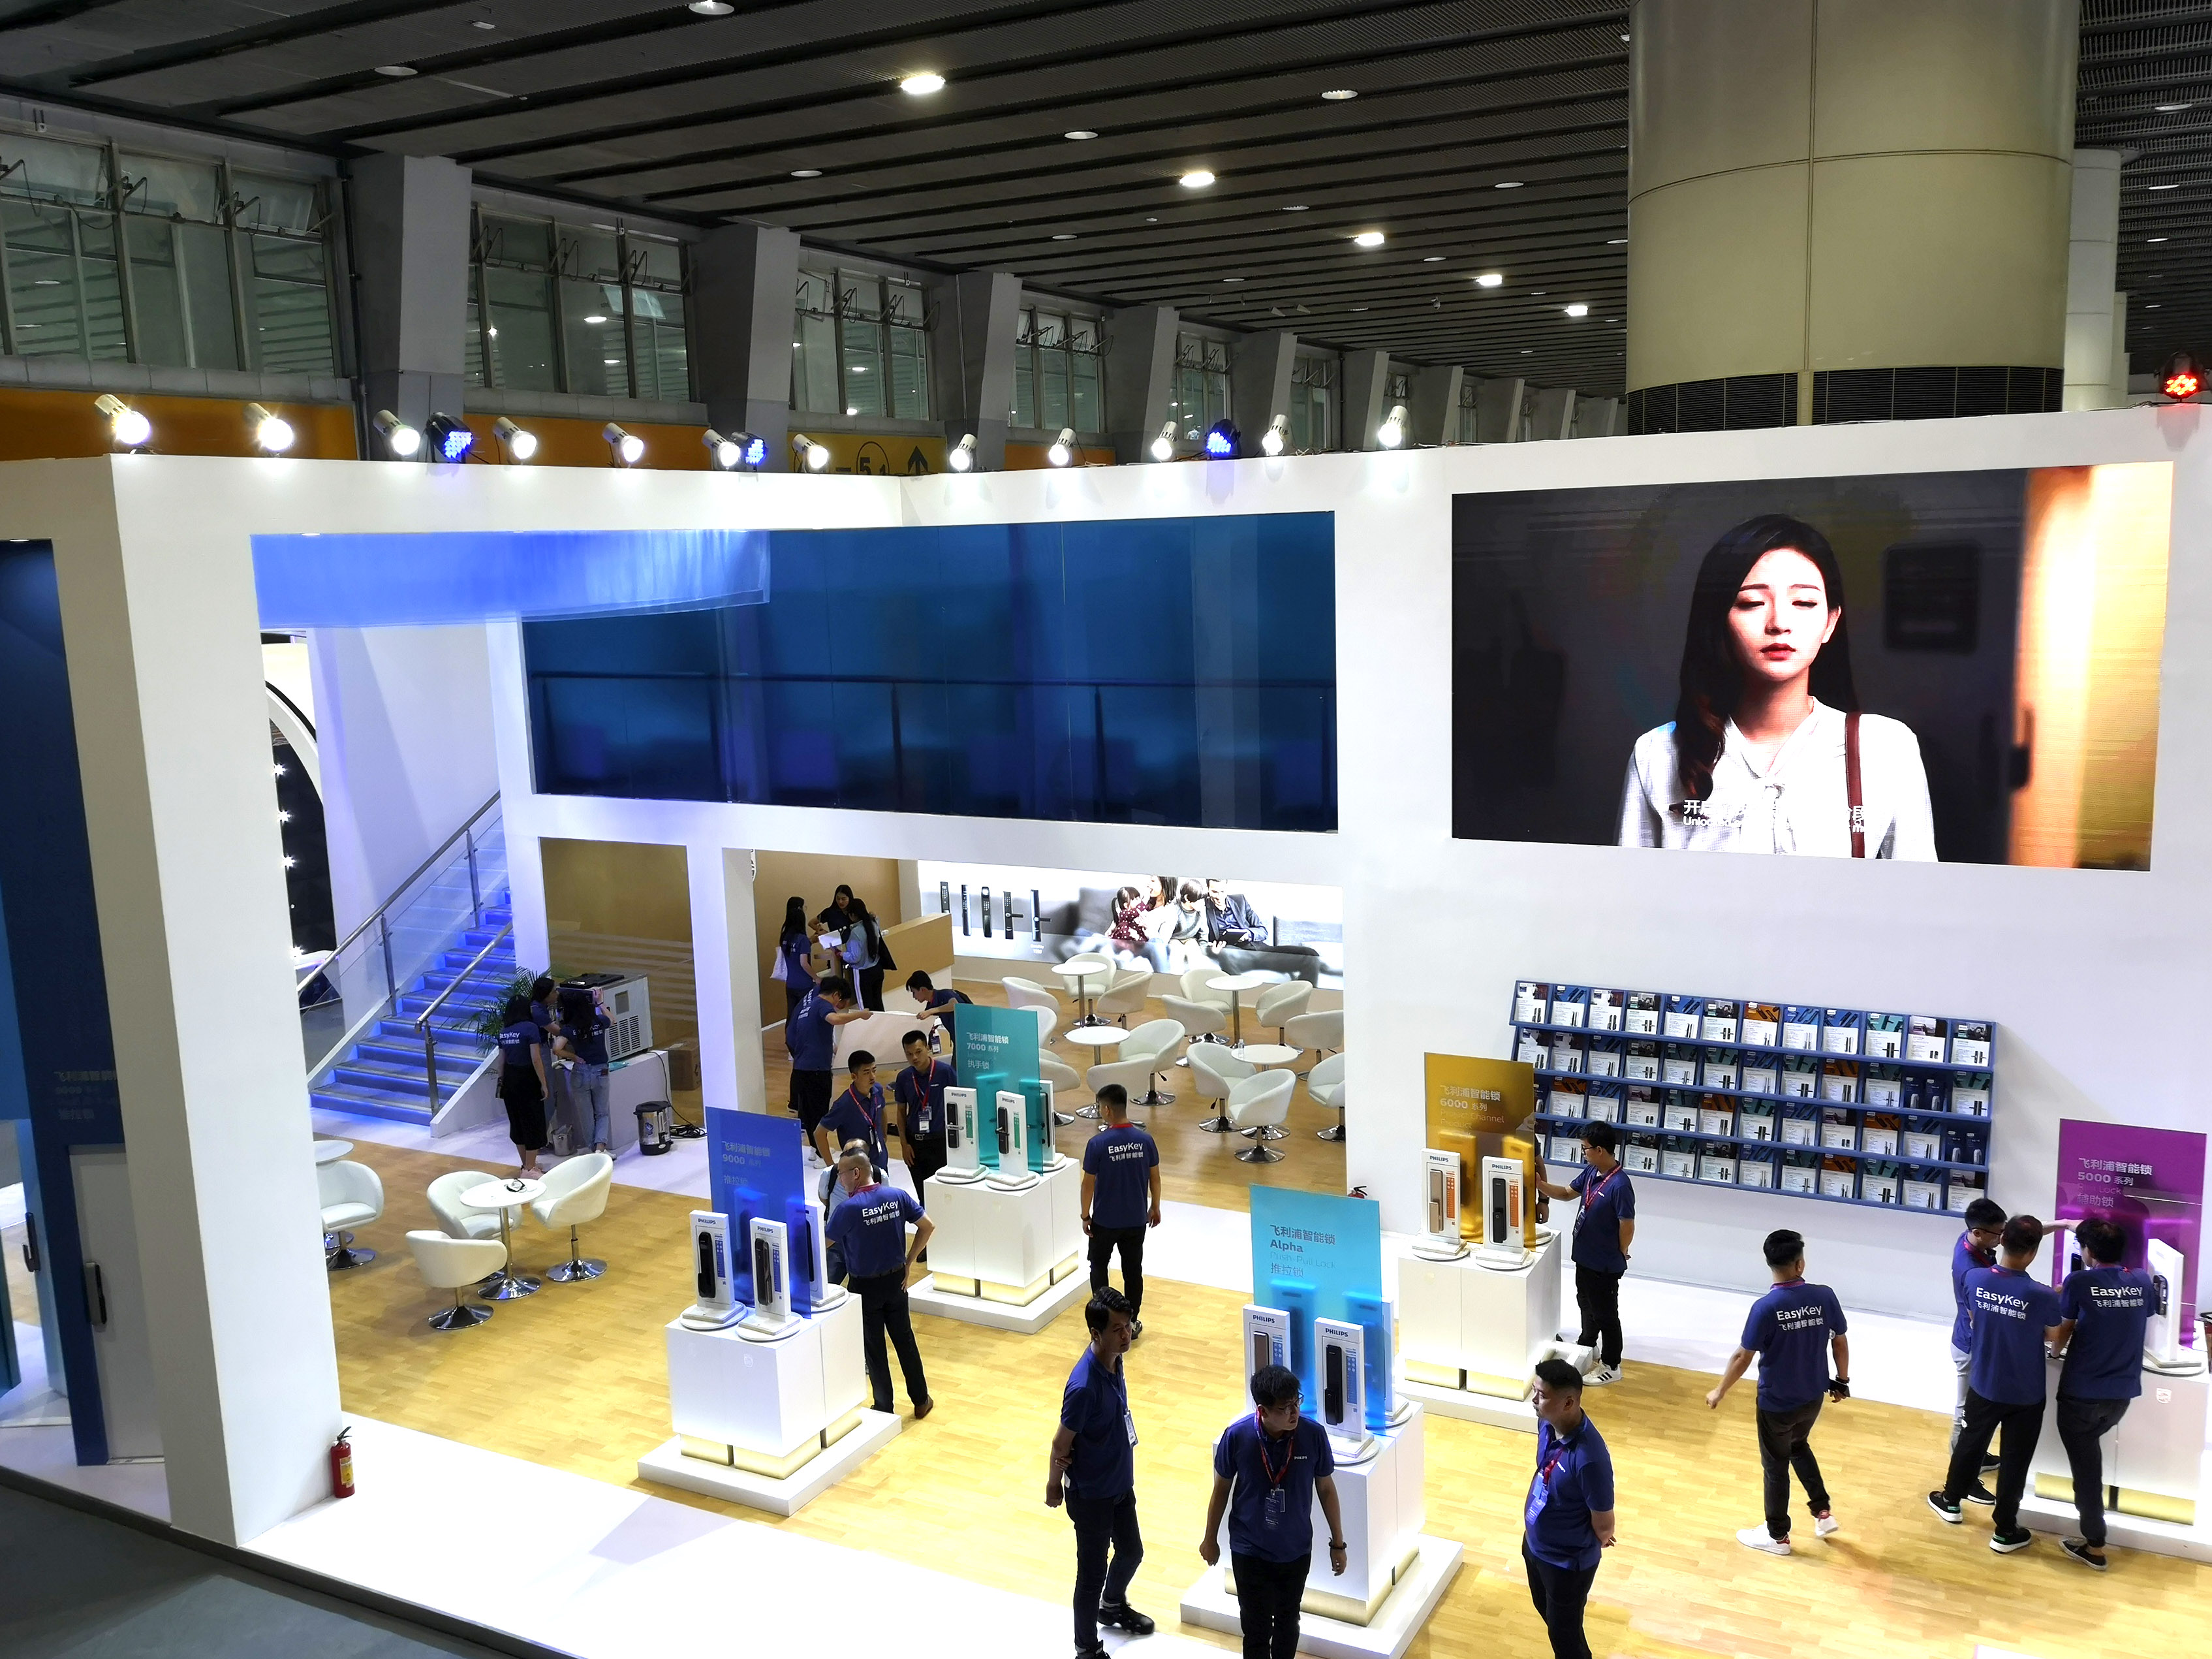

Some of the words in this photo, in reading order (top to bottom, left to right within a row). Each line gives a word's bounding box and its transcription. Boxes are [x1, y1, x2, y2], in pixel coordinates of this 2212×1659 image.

[967, 1043, 986, 1051] 7000
[1440, 1084, 1501, 1101] 飞利浦智能锁
[1440, 1098, 1468, 1109] 6000
[1472, 1102, 1488, 1112] 系列
[1108, 1142, 1143, 1154] EasyKey
[723, 1154, 745, 1165] 9000
[2078, 1158, 2153, 1176] 飞利浦智能锁
[2078, 1171, 2111, 1183] 5000
[2113, 1176, 2134, 1186] 系列
[862, 1201, 898, 1218] EasyKey
[1270, 1224, 1335, 1245] 飞利浦智能锁
[1270, 1239, 1303, 1252] Alpha
[1271, 1262, 1305, 1279] 推拉锁
[1976, 1287, 2029, 1310] EasyKey
[2090, 1286, 2143, 1298] EasyKey
[1776, 1306, 1822, 1320] EasyKey
[1975, 1300, 2027, 1320] 飞利浦智能锁
[1253, 1314, 1275, 1323] PHILIPS
[1325, 1328, 1348, 1337] PHILIPS
